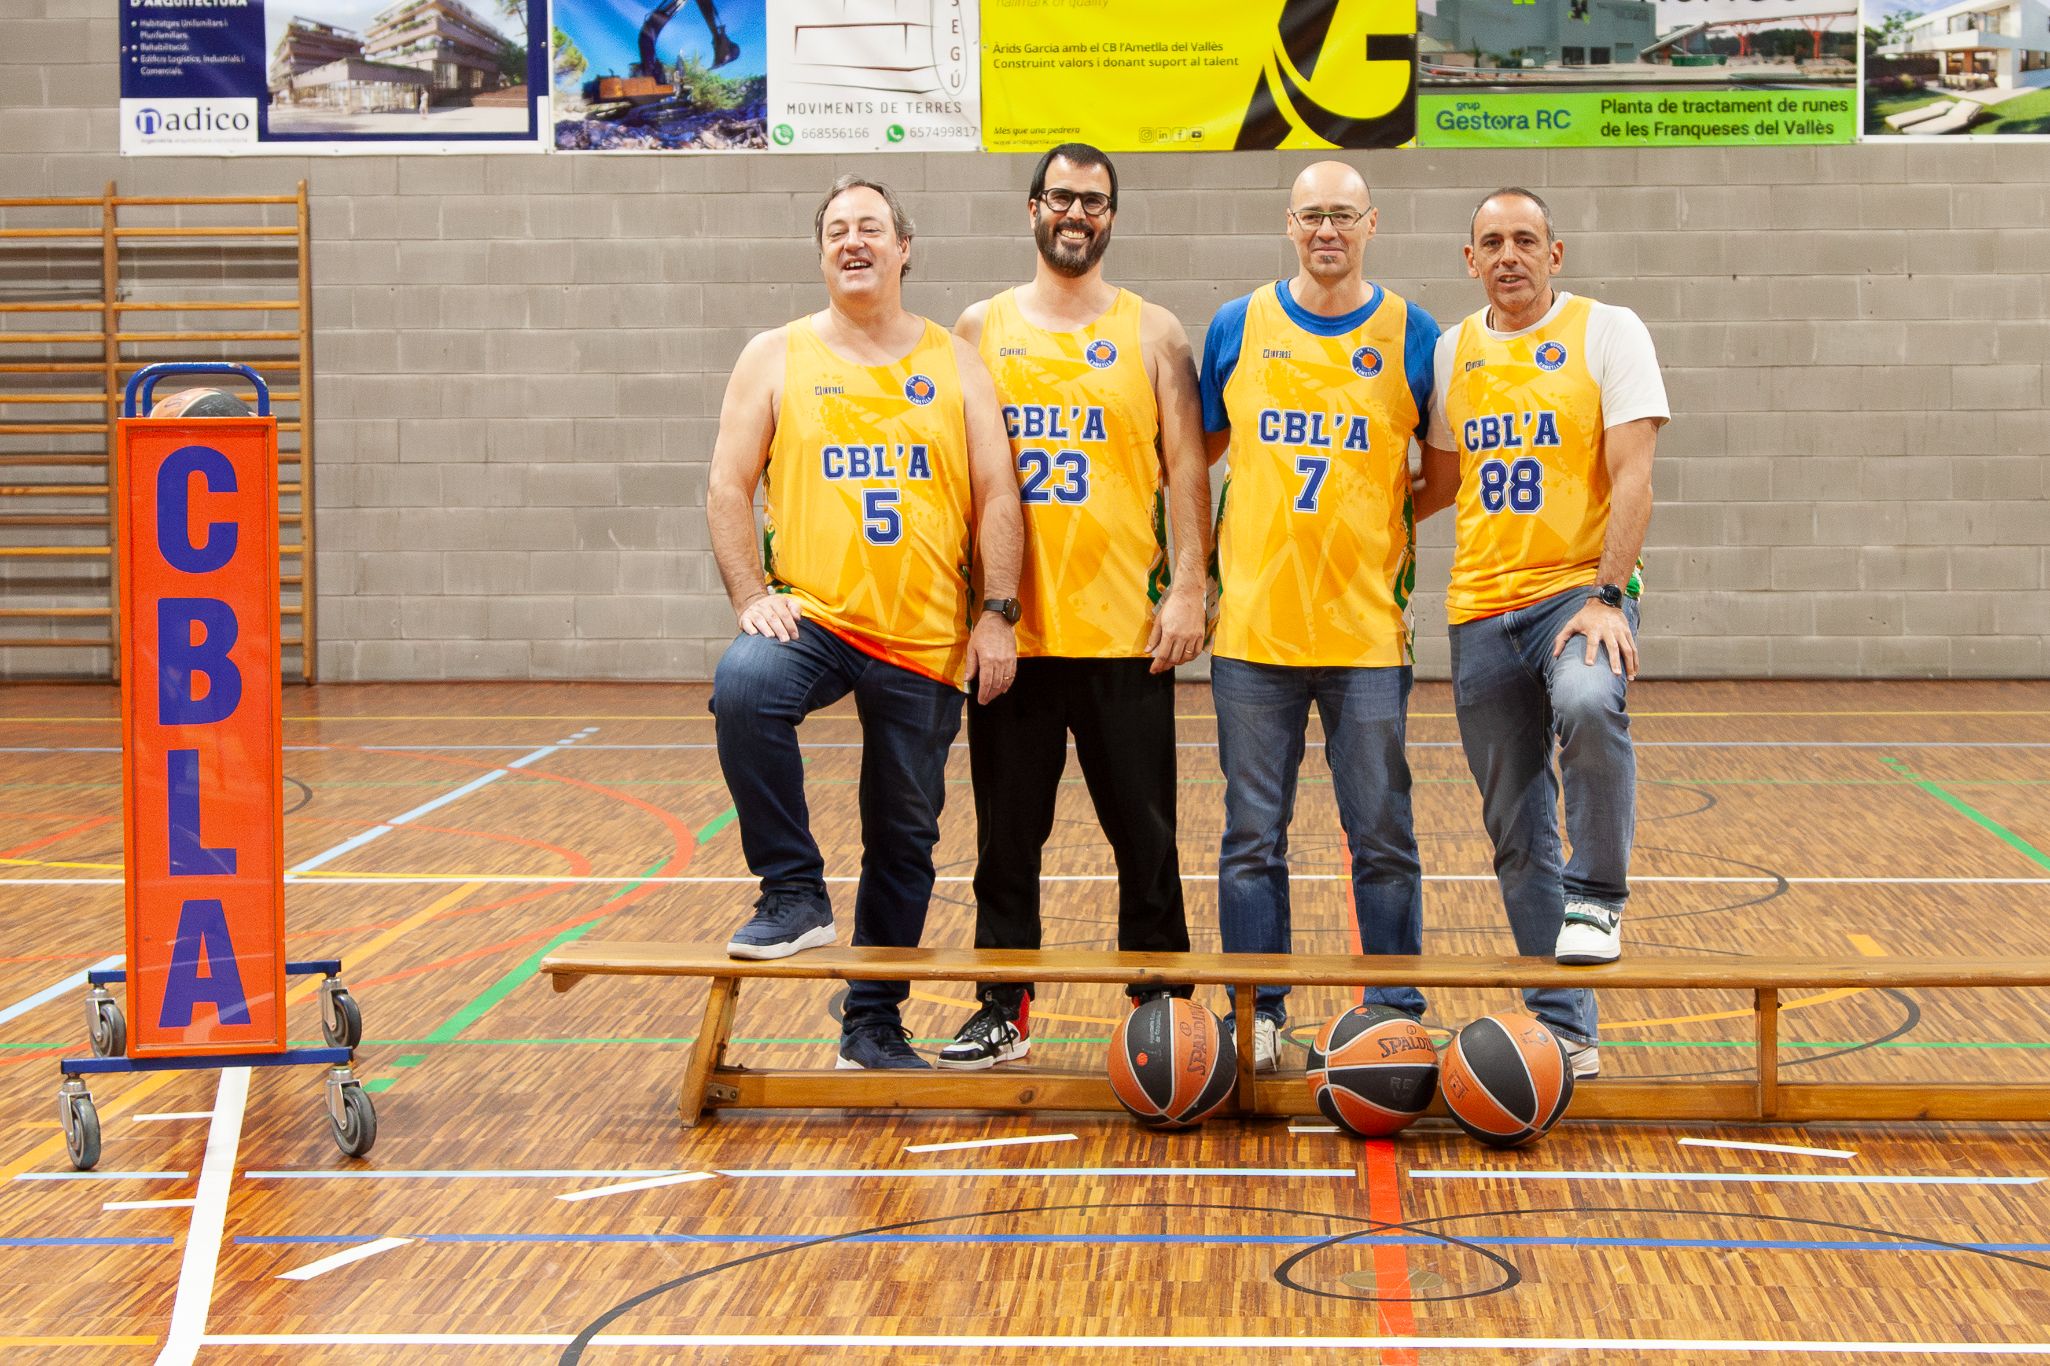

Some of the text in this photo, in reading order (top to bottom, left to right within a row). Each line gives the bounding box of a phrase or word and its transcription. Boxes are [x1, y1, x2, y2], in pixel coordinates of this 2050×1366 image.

[1024, 43, 1059, 54] Garcia
[1061, 43, 1087, 53] amb
[1090, 43, 1099, 53] el
[1102, 43, 1117, 53] CB
[1171, 42, 1188, 52] del
[1190, 42, 1223, 52] Vallès
[993, 58, 1054, 69] Construint
[1059, 57, 1093, 68] valors
[1103, 57, 1145, 67] donant
[1149, 57, 1186, 69] suport
[1190, 56, 1200, 66] al
[1203, 56, 1239, 66] talent
[787, 101, 962, 115] MOVIMENTS DE TERRES
[1456, 102, 1480, 111] grup
[1601, 98, 1848, 114] Planta de tractament de runes
[1436, 109, 1572, 130] Gestora RC
[1601, 120, 1834, 139] de les Franqueses del Vallès
[801, 127, 870, 139] 668556166
[909, 126, 977, 138] 657499817
[1259, 409, 1370, 451] CBL'A
[1464, 411, 1560, 452] CBL'A
[823, 444, 932, 479] CBL'A
[1017, 449, 1089, 504] 23
[1294, 456, 1330, 512] 7
[1479, 457, 1543, 514] 88
[862, 488, 902, 545] 5
